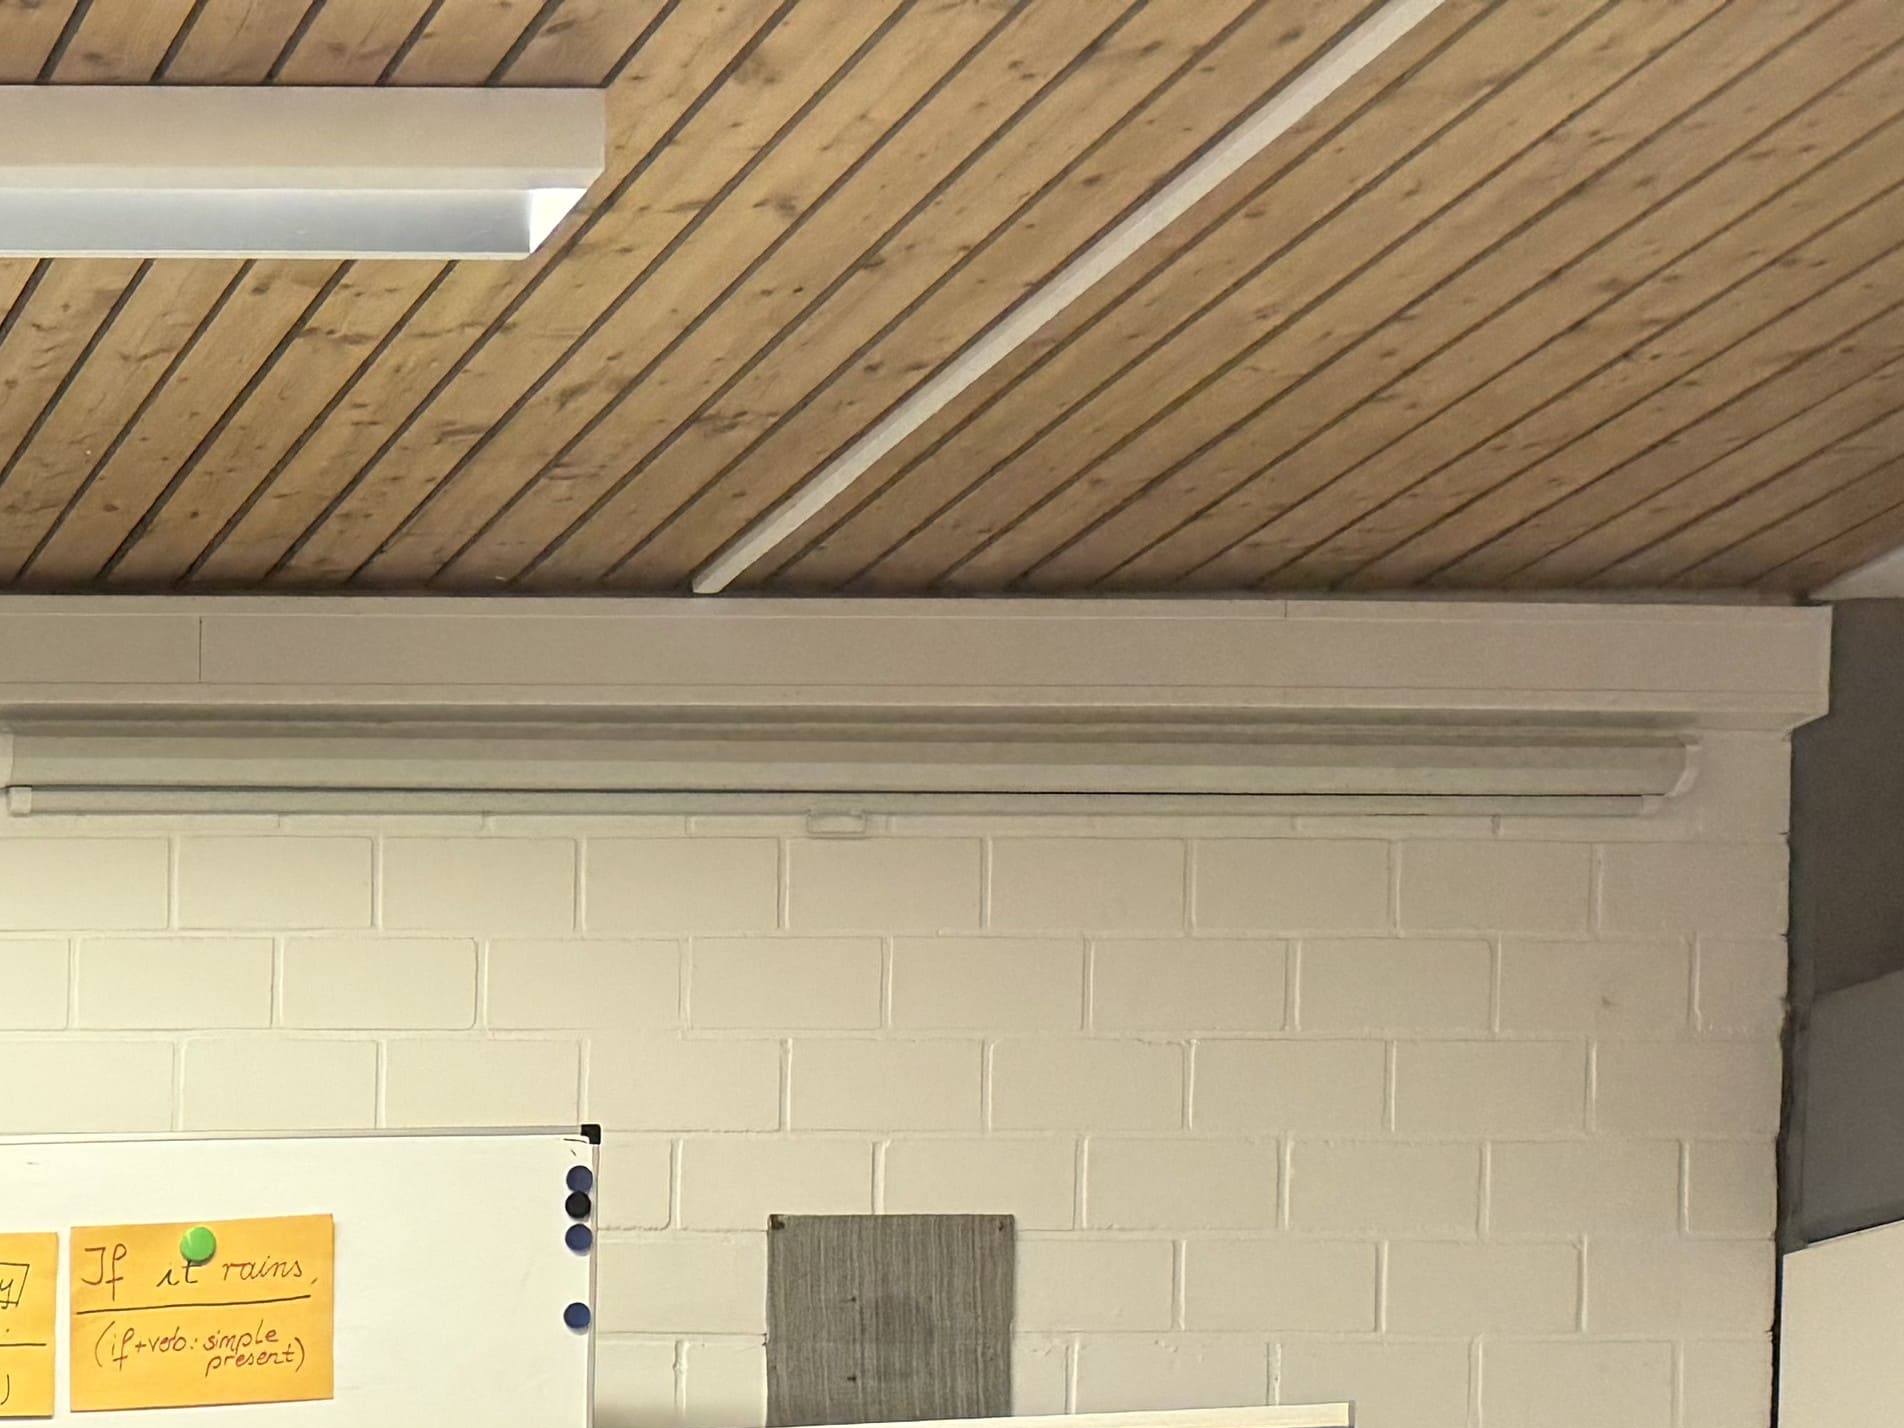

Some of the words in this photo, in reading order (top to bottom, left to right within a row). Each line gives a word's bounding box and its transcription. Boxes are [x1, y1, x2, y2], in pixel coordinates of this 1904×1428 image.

[84, 1243, 128, 1302] If
[155, 1255, 200, 1288] it
[202, 1319, 279, 1353] simple
[205, 1336, 305, 1377] present)
